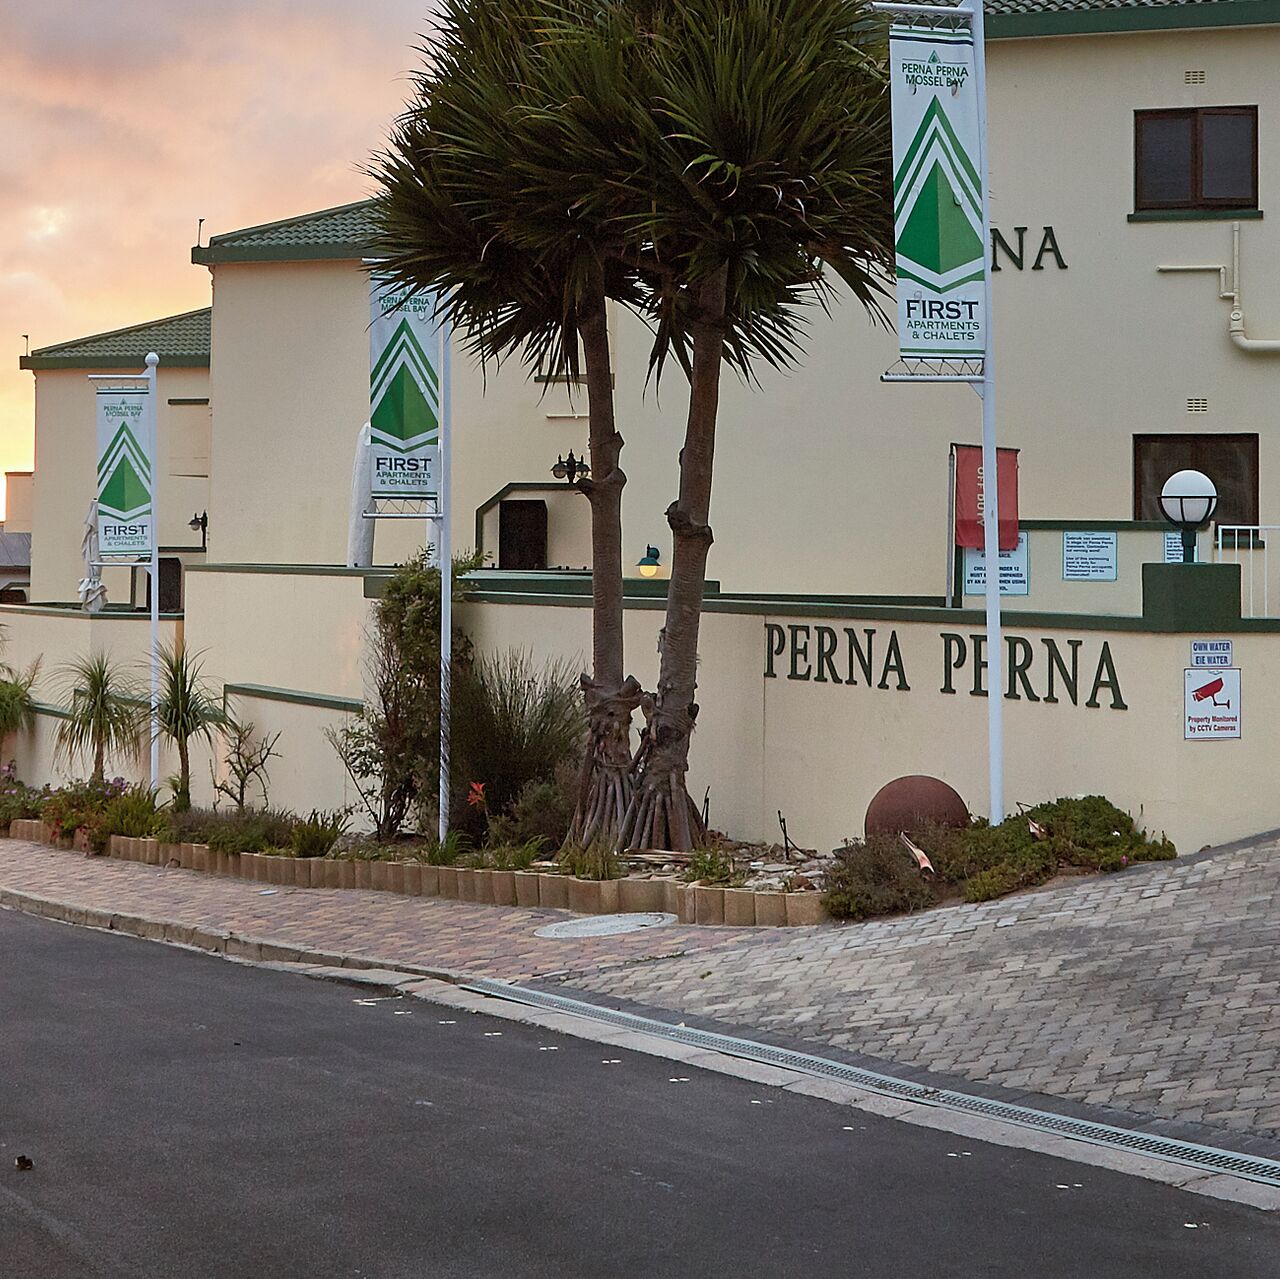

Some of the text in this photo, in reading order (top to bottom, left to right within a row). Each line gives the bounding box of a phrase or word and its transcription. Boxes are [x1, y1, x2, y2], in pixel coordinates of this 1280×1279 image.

[902, 63, 968, 77] PERNA PERNA
[906, 74, 964, 88] MOSSEL BAY
[406, 297, 430, 305] ERNA
[906, 299, 978, 319] FIRST
[907, 320, 980, 330] APARTMENTS
[912, 331, 975, 340] & CHALETS
[376, 457, 431, 471] FIRST
[104, 525, 148, 535] FIRST
[1193, 642, 1230, 651] OWN WATER
[1195, 656, 1228, 664] EIE WATER
[764, 623, 1128, 710] PERNA PERNA
[1188, 716, 1210, 724] Property
[1190, 725, 1195, 733] by
